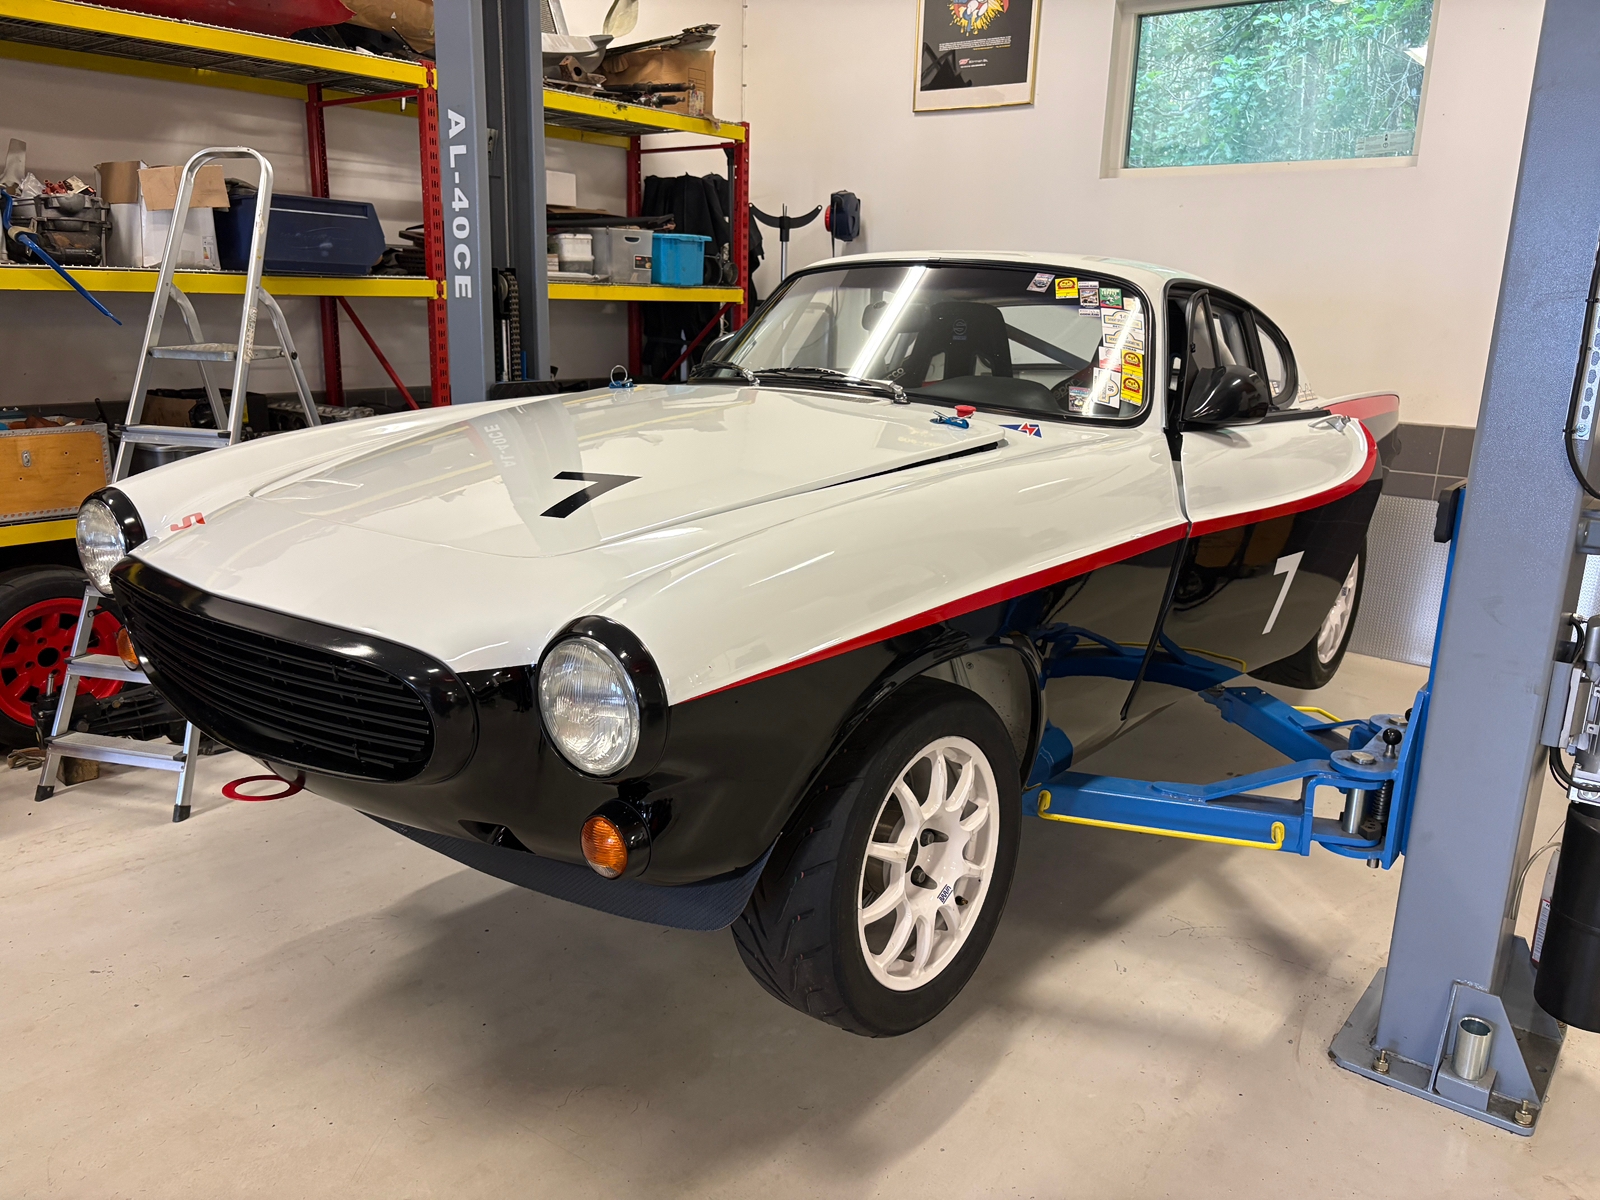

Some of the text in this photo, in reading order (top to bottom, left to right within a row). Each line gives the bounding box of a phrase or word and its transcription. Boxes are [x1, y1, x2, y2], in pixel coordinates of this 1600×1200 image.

[447, 108, 472, 299] AL-40CE
[539, 471, 643, 519] 7
[1261, 550, 1306, 635] 7
